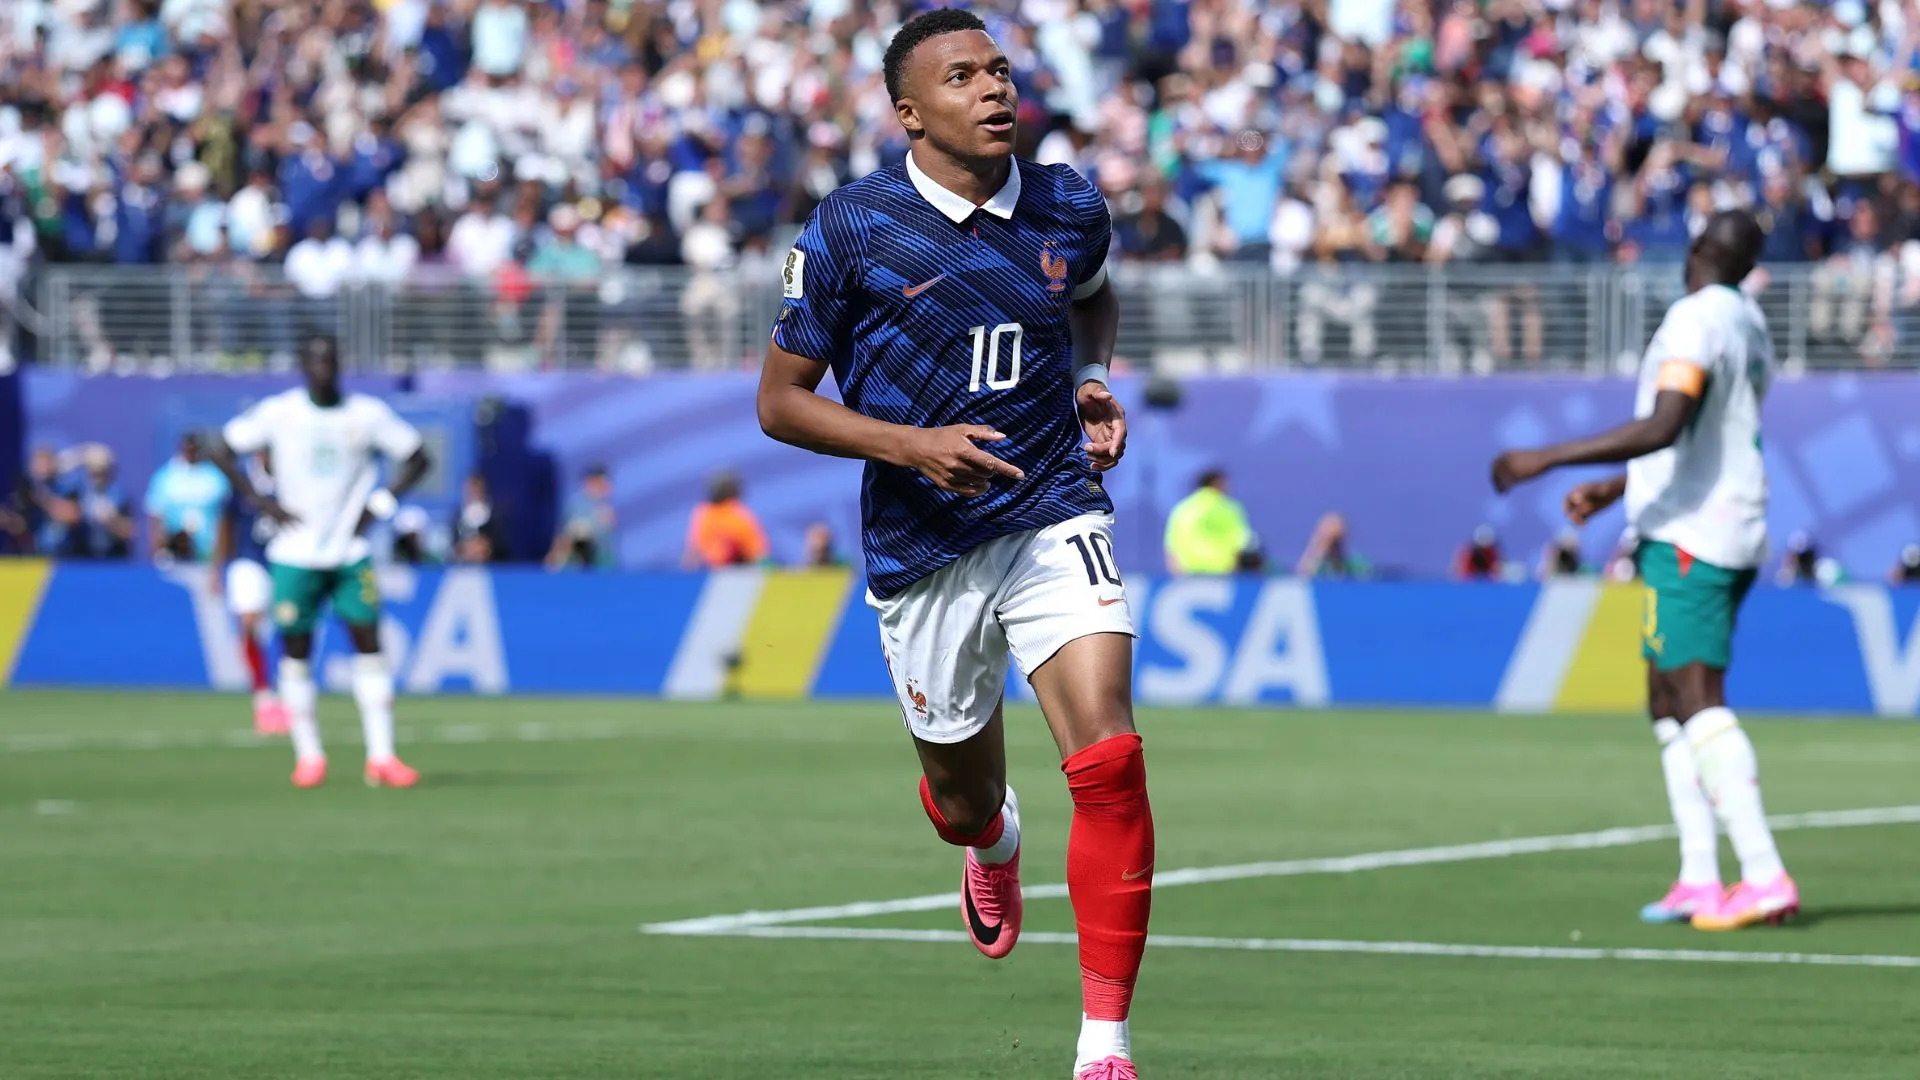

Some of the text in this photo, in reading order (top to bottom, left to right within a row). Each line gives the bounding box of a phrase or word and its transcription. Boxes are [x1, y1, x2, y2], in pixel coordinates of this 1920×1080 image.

[968, 322, 1024, 392] 10
[1065, 531, 1123, 588] 10
[157, 562, 511, 692] VSA
